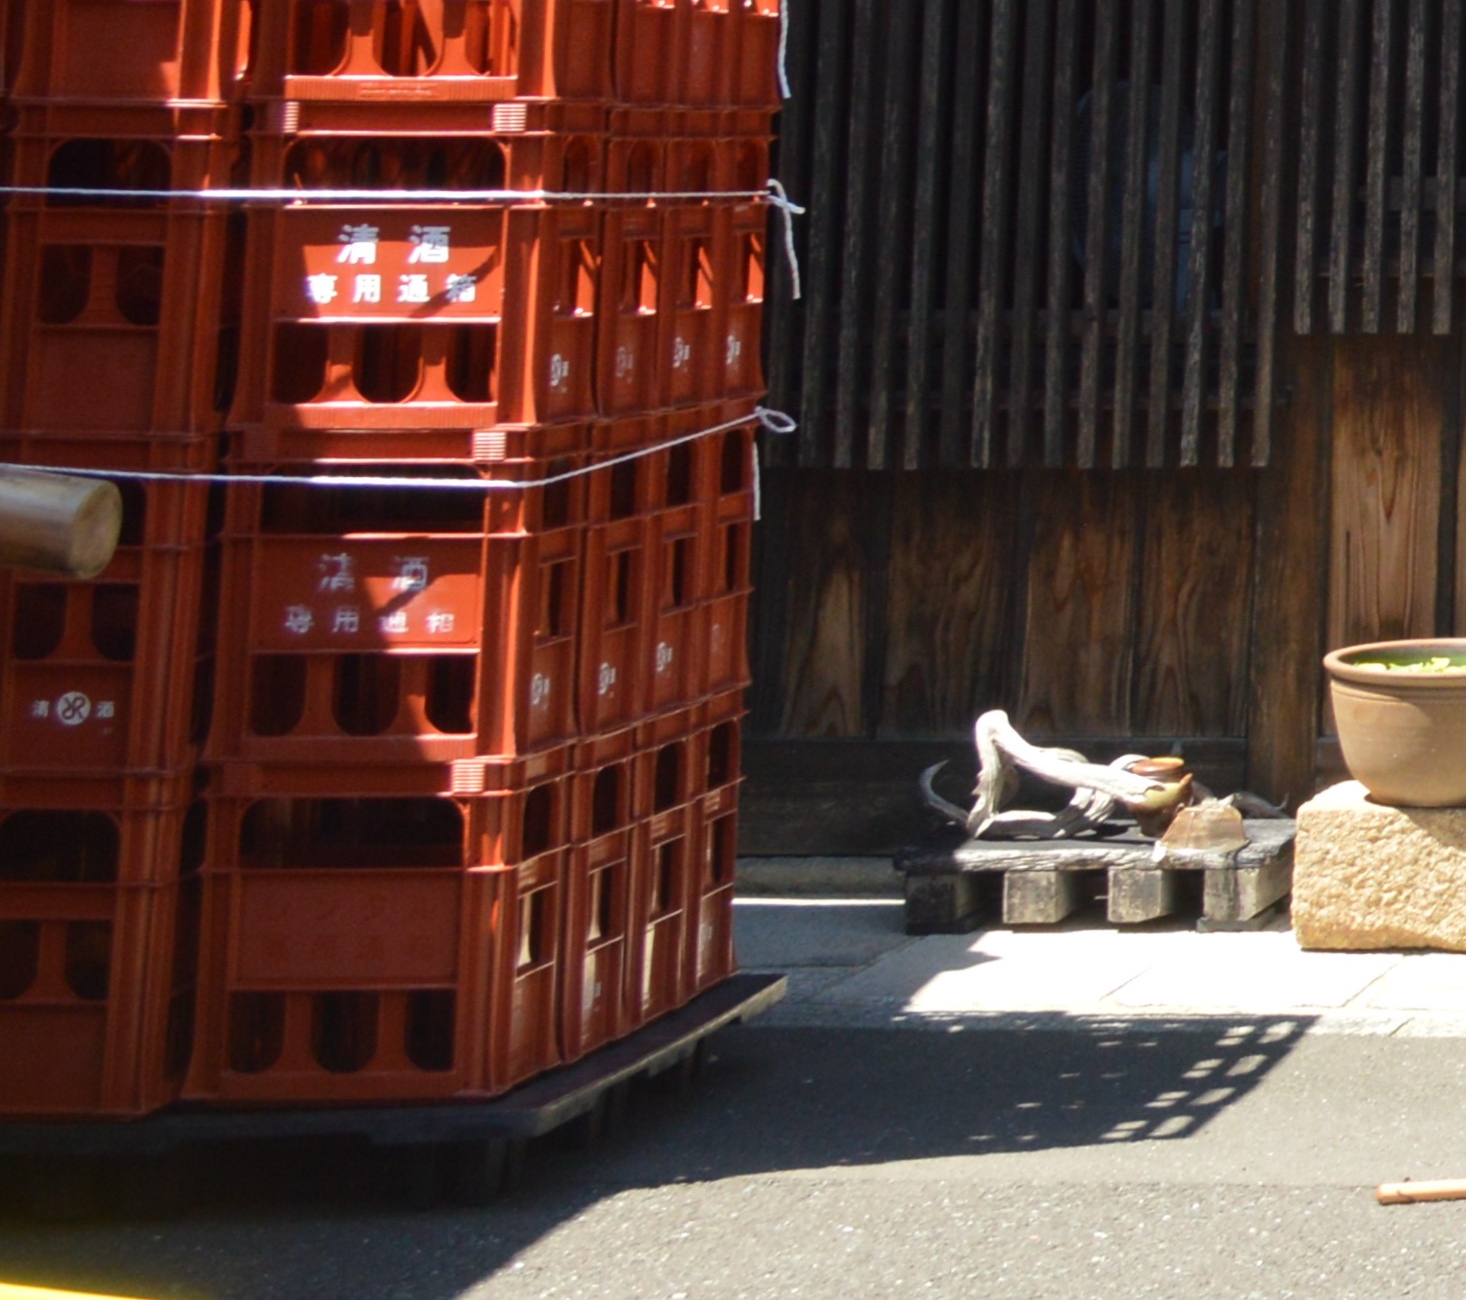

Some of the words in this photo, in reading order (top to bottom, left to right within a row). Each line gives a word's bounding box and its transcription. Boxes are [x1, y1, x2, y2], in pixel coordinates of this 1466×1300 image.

[336, 223, 451, 264] 清酒
[306, 272, 477, 304] 専用通箱
